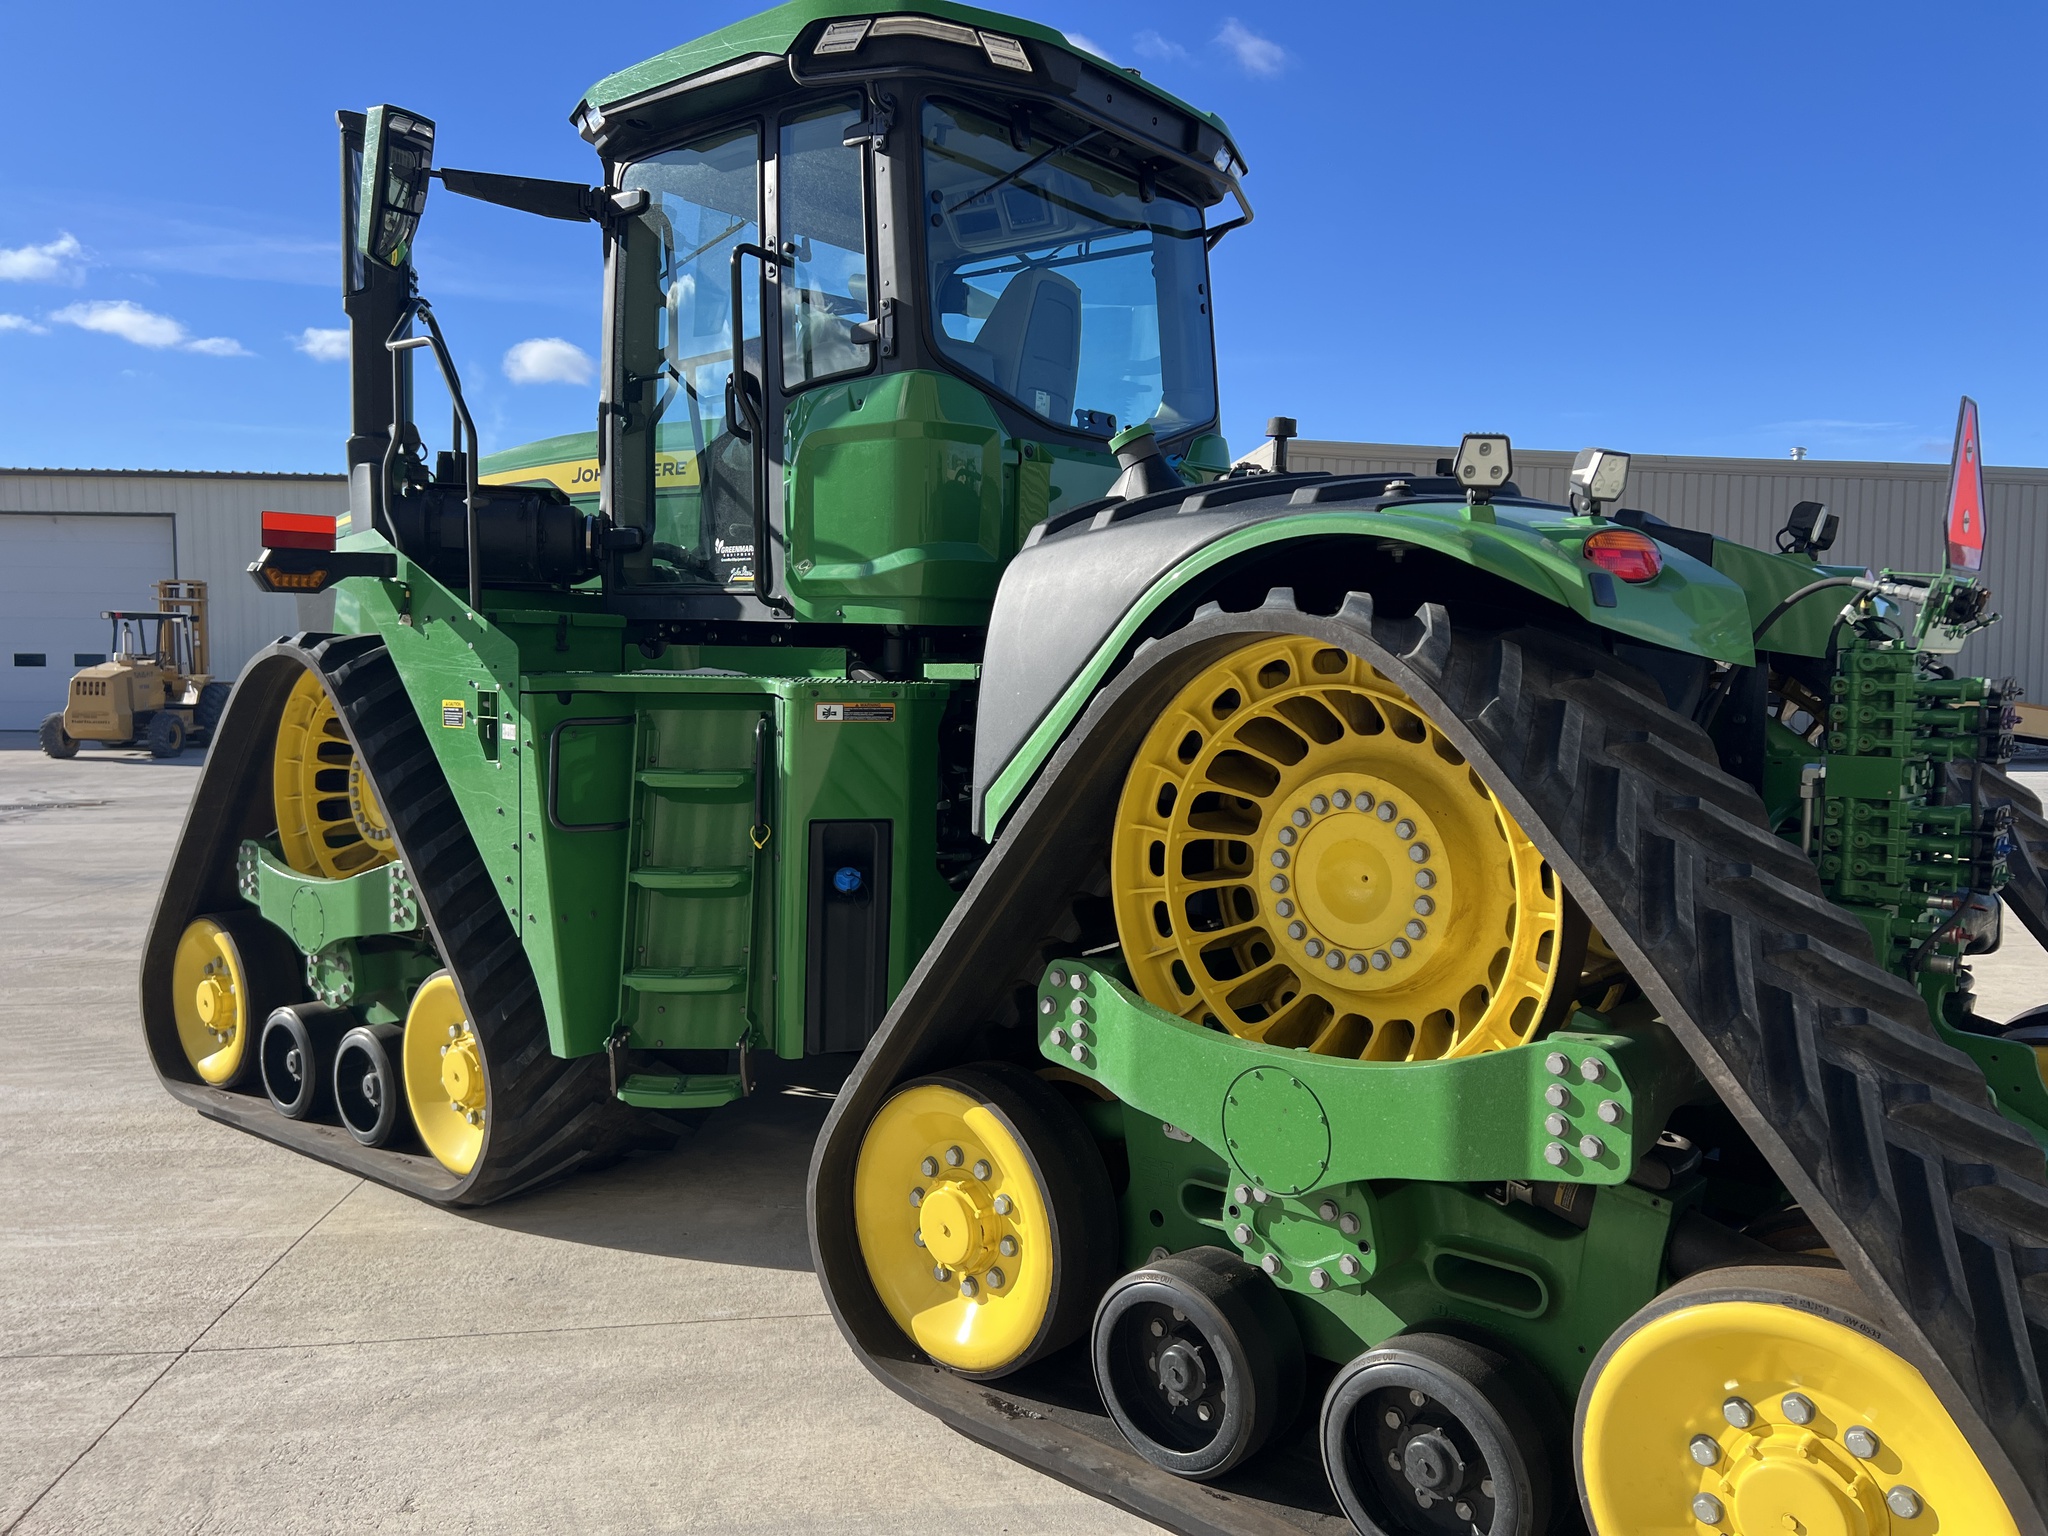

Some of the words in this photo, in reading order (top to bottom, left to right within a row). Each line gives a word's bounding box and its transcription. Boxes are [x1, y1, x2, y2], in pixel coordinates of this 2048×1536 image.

[572, 467, 600, 483] JOH
[655, 461, 687, 476] ERE
[721, 545, 754, 553] GREENMAR
[1382, 1353, 1398, 1361] OUT
